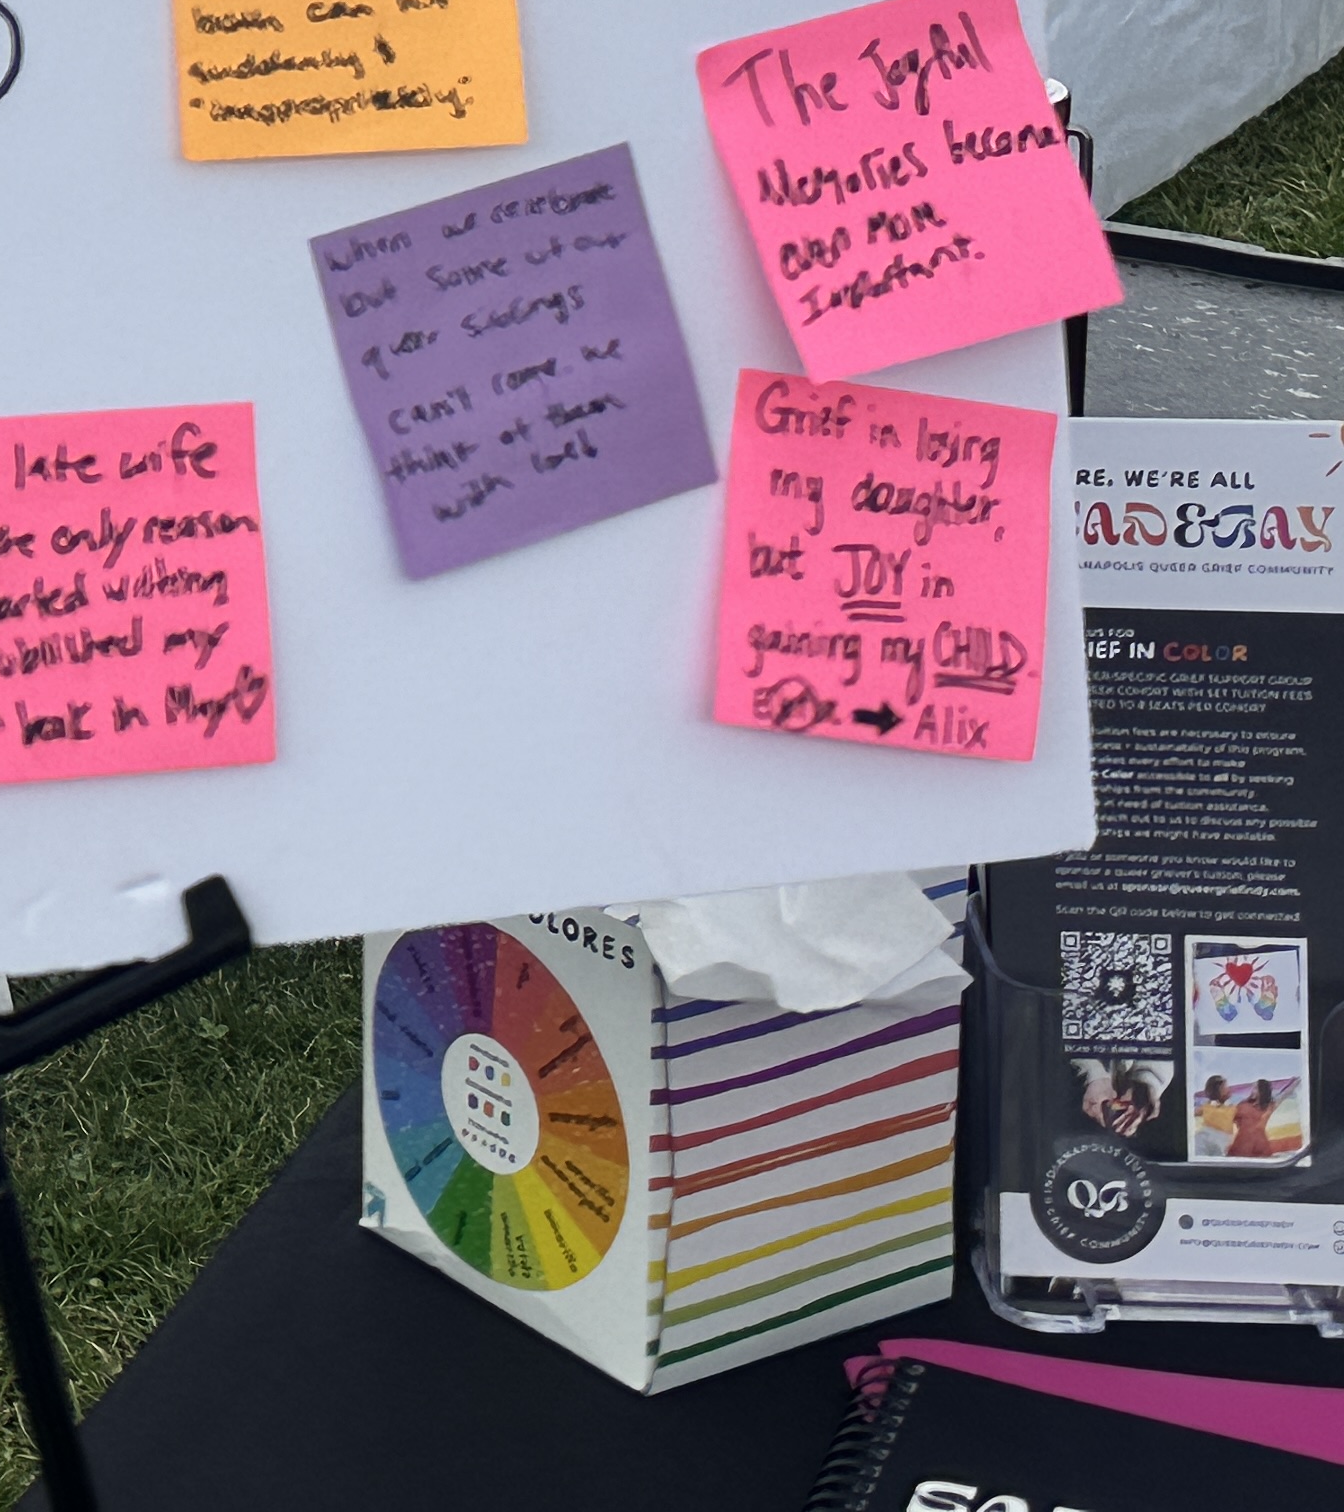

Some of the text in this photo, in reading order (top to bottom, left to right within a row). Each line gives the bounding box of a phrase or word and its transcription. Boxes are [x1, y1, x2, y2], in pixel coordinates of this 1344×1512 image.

[722, 11, 991, 127] The Joyful
[758, 142, 927, 205] Memories
[15, 442, 103, 490] late
[120, 422, 218, 479] wife
[755, 379, 1001, 489] Grief in losing
[770, 469, 824, 536] my
[1076, 469, 1255, 489] RE, WE'RE ALL
[51, 507, 137, 569] only
[749, 532, 955, 598] but JOY in
[1248, 564, 1334, 575] COMMUNITY
[743, 620, 862, 686] gaining
[881, 634, 926, 705] my
[1087, 640, 1248, 662] IEF IN COLOR
[914, 704, 989, 748] Alix
[527, 911, 637, 970] LORES
